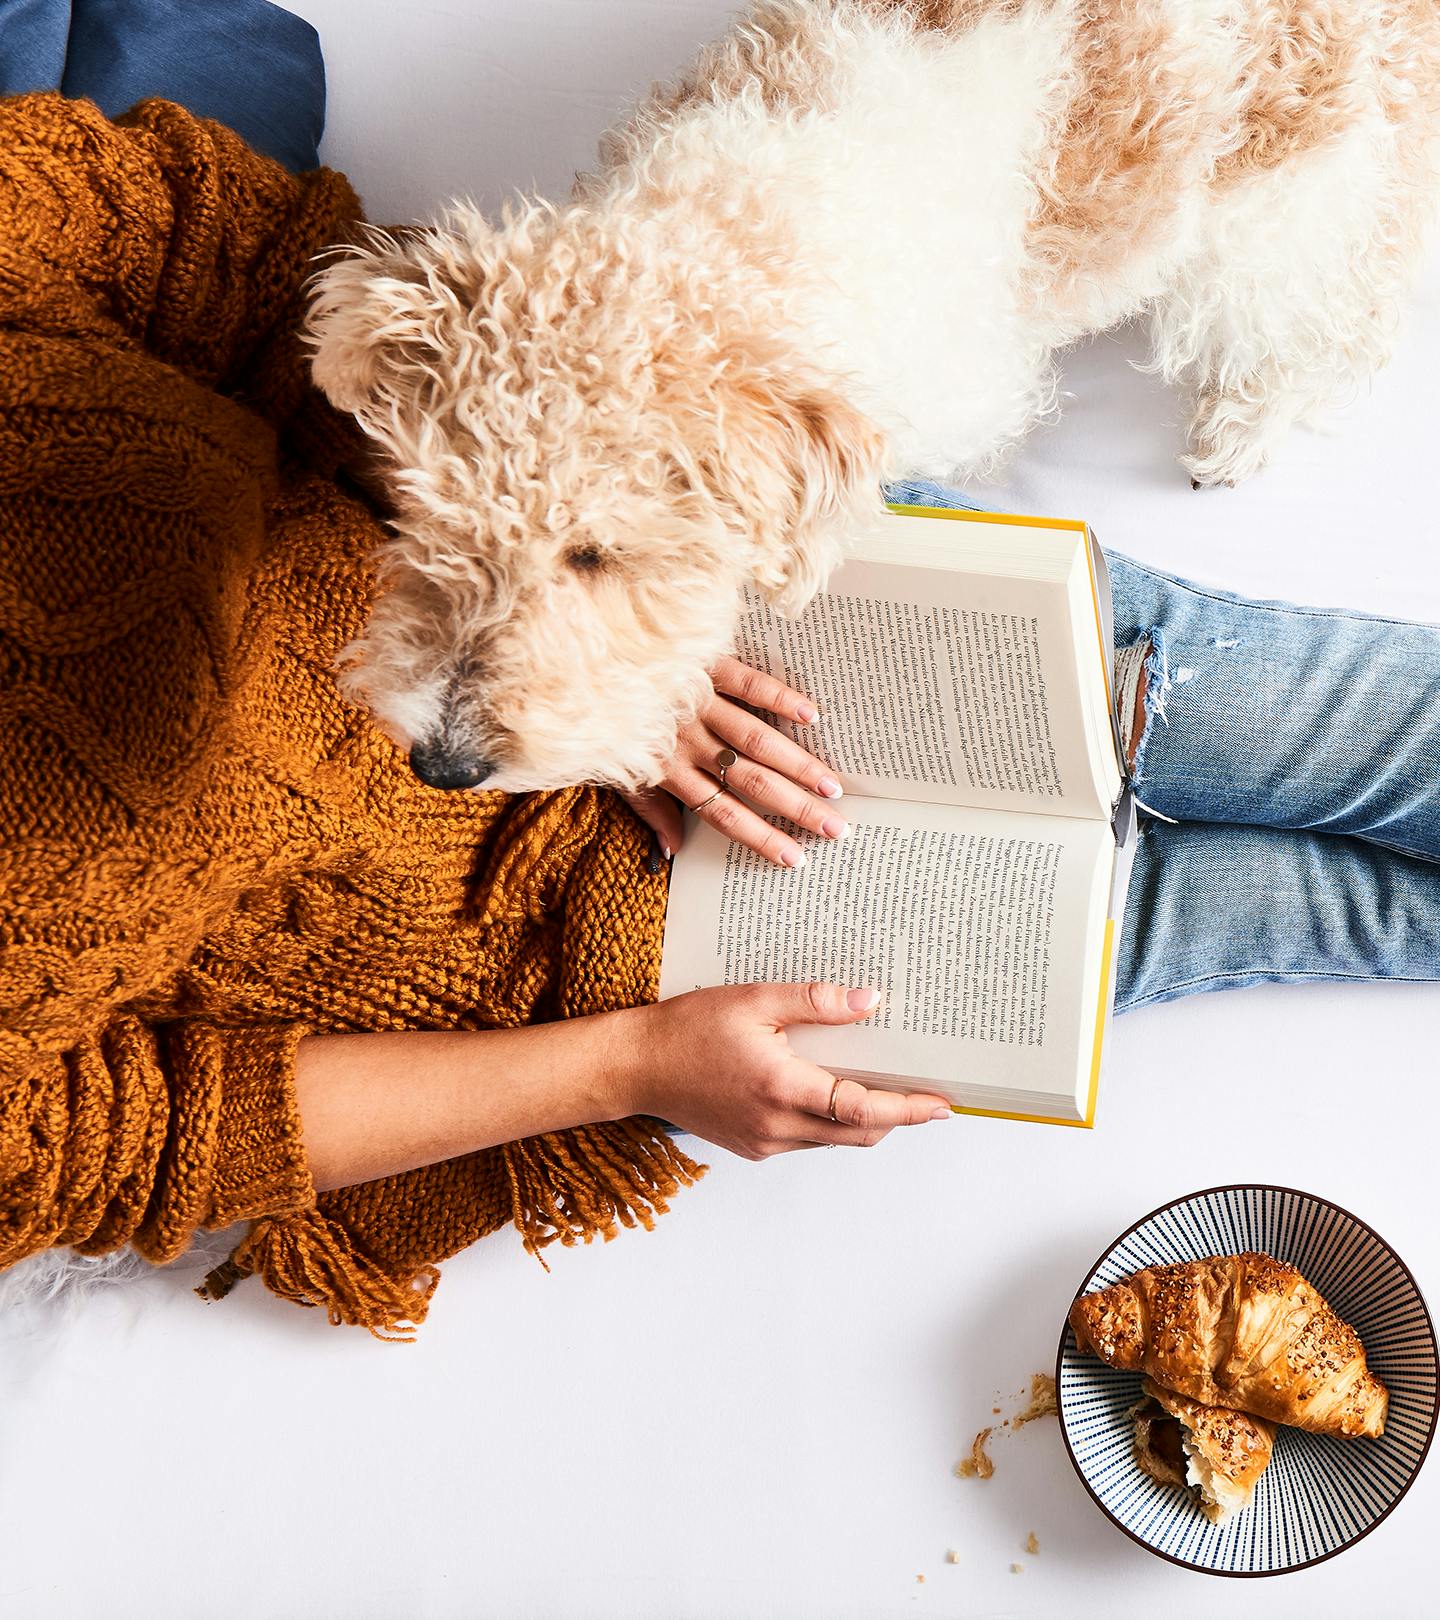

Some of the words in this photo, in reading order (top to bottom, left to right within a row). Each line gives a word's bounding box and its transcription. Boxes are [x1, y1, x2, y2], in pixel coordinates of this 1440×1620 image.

[895, 849, 906, 873] kannte
[975, 835, 987, 861] Million
[984, 836, 996, 860] seinem
[993, 837, 1006, 866] vierzehn
[1012, 839, 1025, 868] bisschen
[962, 849, 974, 876] erklärte
[971, 862, 982, 885] Dollar
[982, 861, 991, 878] Platz
[893, 874, 901, 894] einen
[957, 876, 969, 905] Clooney
[1007, 869, 1020, 910] unheimlich
[1016, 872, 1029, 903] plötzlich
[909, 891, 919, 920] Schulen
[919, 896, 928, 916] keine
[978, 893, 987, 912] Tisch
[976, 912, 984, 932] einen
[916, 917, 926, 954] Gedanken
[953, 919, 965, 957] sinngemäß
[887, 944, 895, 971] ähnlich
[906, 941, 915, 965] Kinder
[1000, 950, 1011, 977] Gruppe
[885, 970, 894, 991] nobel
[904, 966, 913, 1001] finanziert
[913, 975, 922, 1003] darüber
[962, 972, 970, 990] einer
[970, 976, 980, 1000] gefüllt
[1001, 979, 1009, 996] alter
[961, 990, 970, 1017] kleinen
[979, 992, 989, 1010] jeder
[999, 997, 1008, 1026] Freunde
[883, 1006, 891, 1029] Onkel
[911, 1004, 920, 1032] machen
[950, 1006, 959, 1037] bedeutet
[959, 1018, 968, 1040] Tisch-
[969, 1021, 977, 1039] einer
